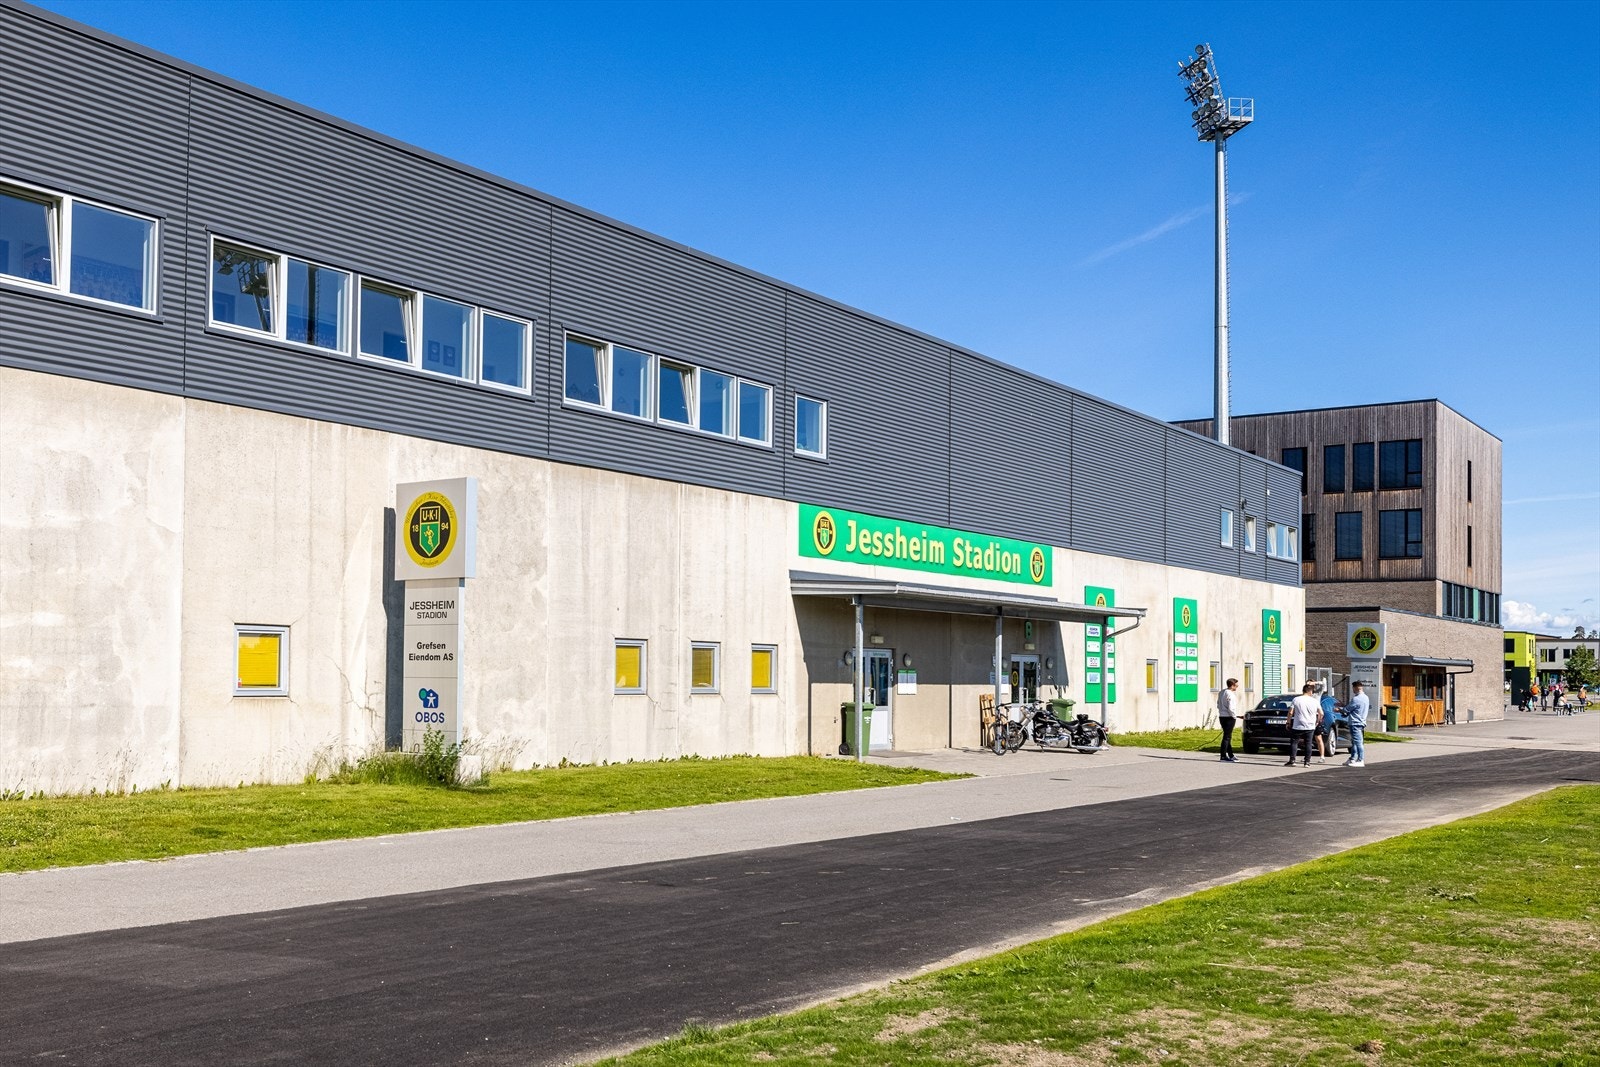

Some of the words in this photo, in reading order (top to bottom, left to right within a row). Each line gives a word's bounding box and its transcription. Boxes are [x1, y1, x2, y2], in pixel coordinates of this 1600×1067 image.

[412, 524, 419, 533] 18
[441, 522, 449, 531] 94
[845, 520, 945, 565] Jessheim
[952, 537, 1022, 575] Stadion
[410, 600, 455, 610] JESSHEIM
[416, 611, 448, 619] STADION
[416, 642, 446, 650] Grefsen
[408, 653, 441, 661] Eiendom
[442, 653, 454, 661] AS
[415, 711, 445, 723] OBOS
